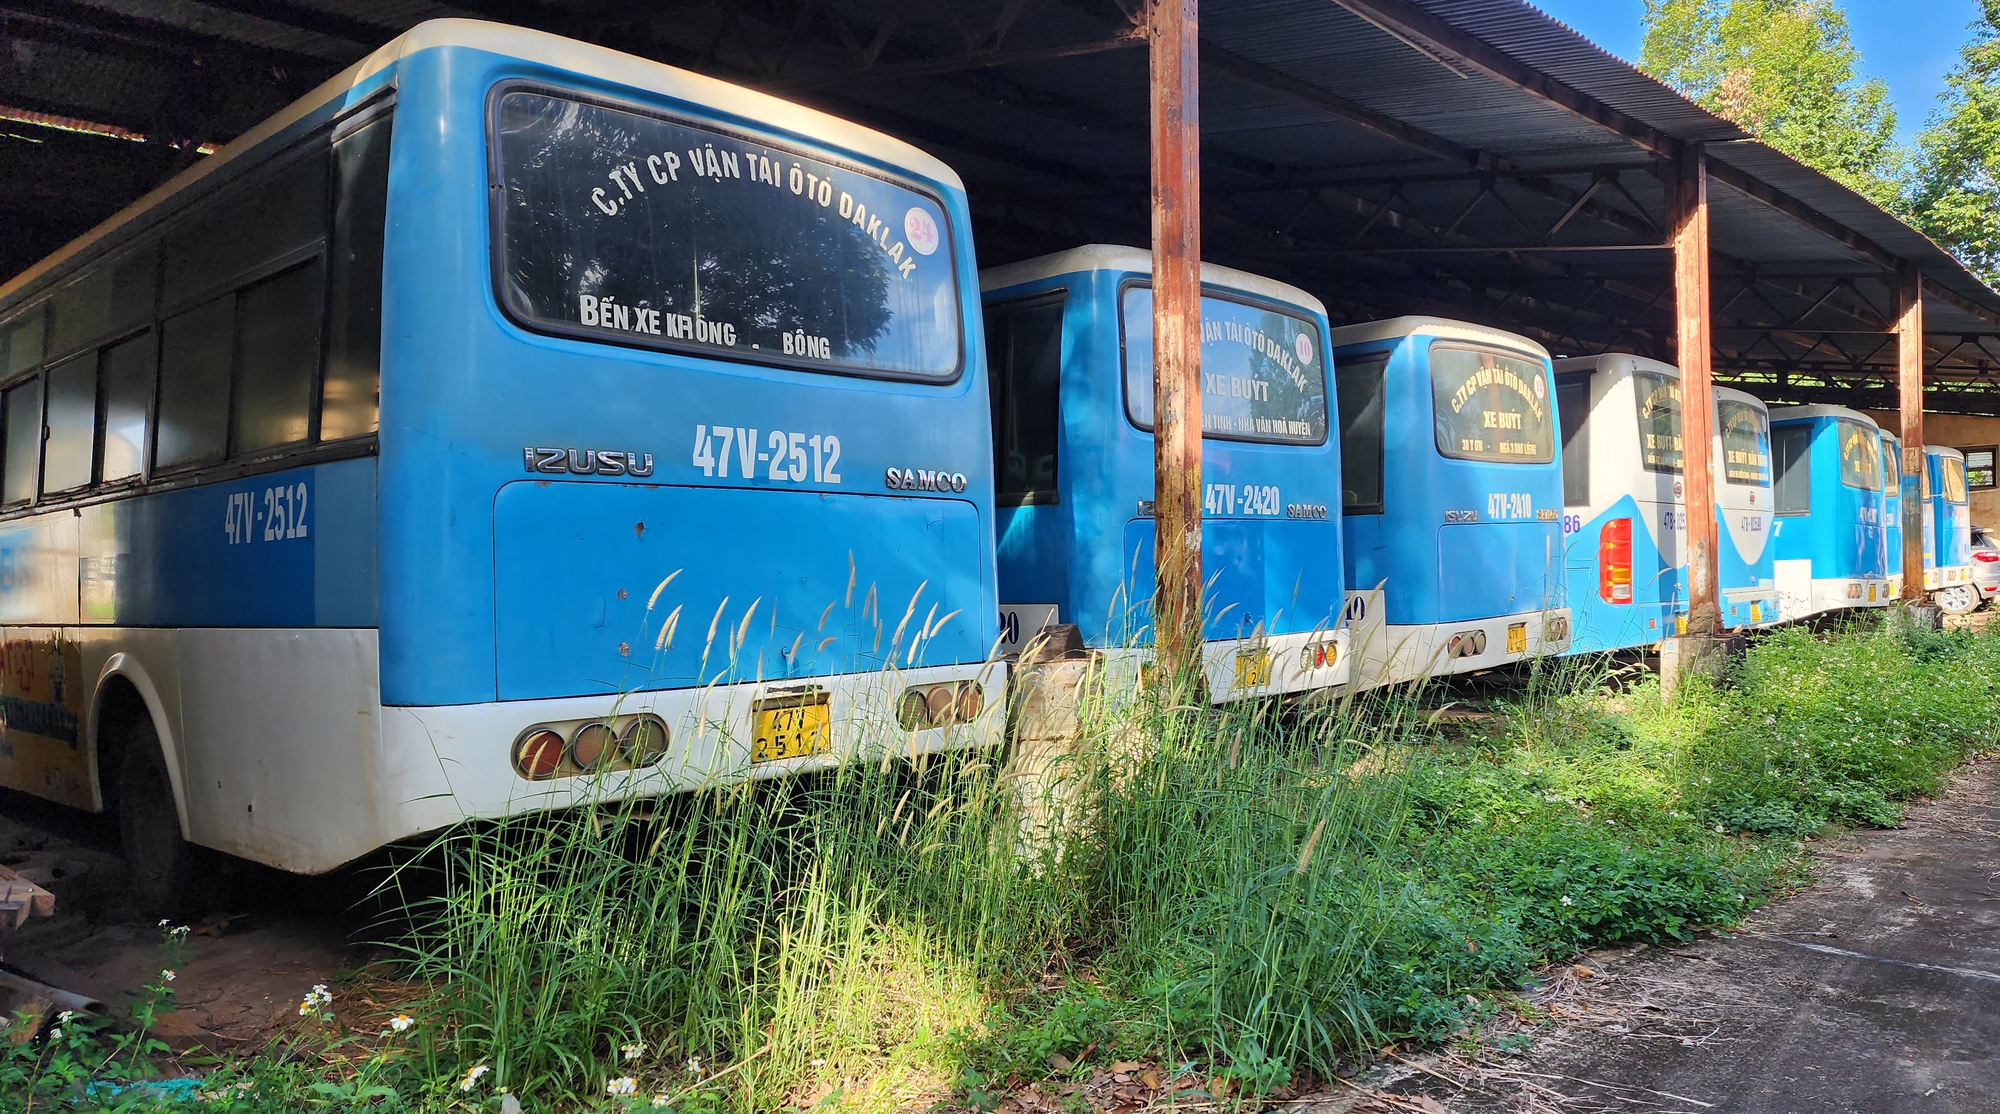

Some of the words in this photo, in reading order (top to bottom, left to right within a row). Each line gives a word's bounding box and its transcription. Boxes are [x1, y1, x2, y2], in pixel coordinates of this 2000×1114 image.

[646, 151, 681, 185] CP
[838, 191, 917, 280] DAKLAK
[909, 216, 935, 244] 24
[579, 294, 629, 332] BẾN
[633, 307, 661, 336] XE
[782, 328, 831, 360] BÔNG
[1299, 340, 1310, 358] 10
[1266, 338, 1308, 393] DAKLAK
[1204, 372, 1227, 396] XE
[1230, 373, 1269, 402] BUÝT
[1465, 375, 1477, 396] CP
[1483, 410, 1498, 428] XE
[1498, 408, 1522, 430] BUÝT
[692, 424, 842, 484] 47V-2512
[885, 466, 968, 494] SAMCO
[1205, 483, 1281, 516] 47V-2420
[1286, 503, 1327, 520] SAMCO
[1487, 493, 1532, 520] 47V-2410
[225, 482, 308, 546] 47V-2512
[1564, 514, 1581, 534] 86
[1773, 520, 1783, 537] 7
